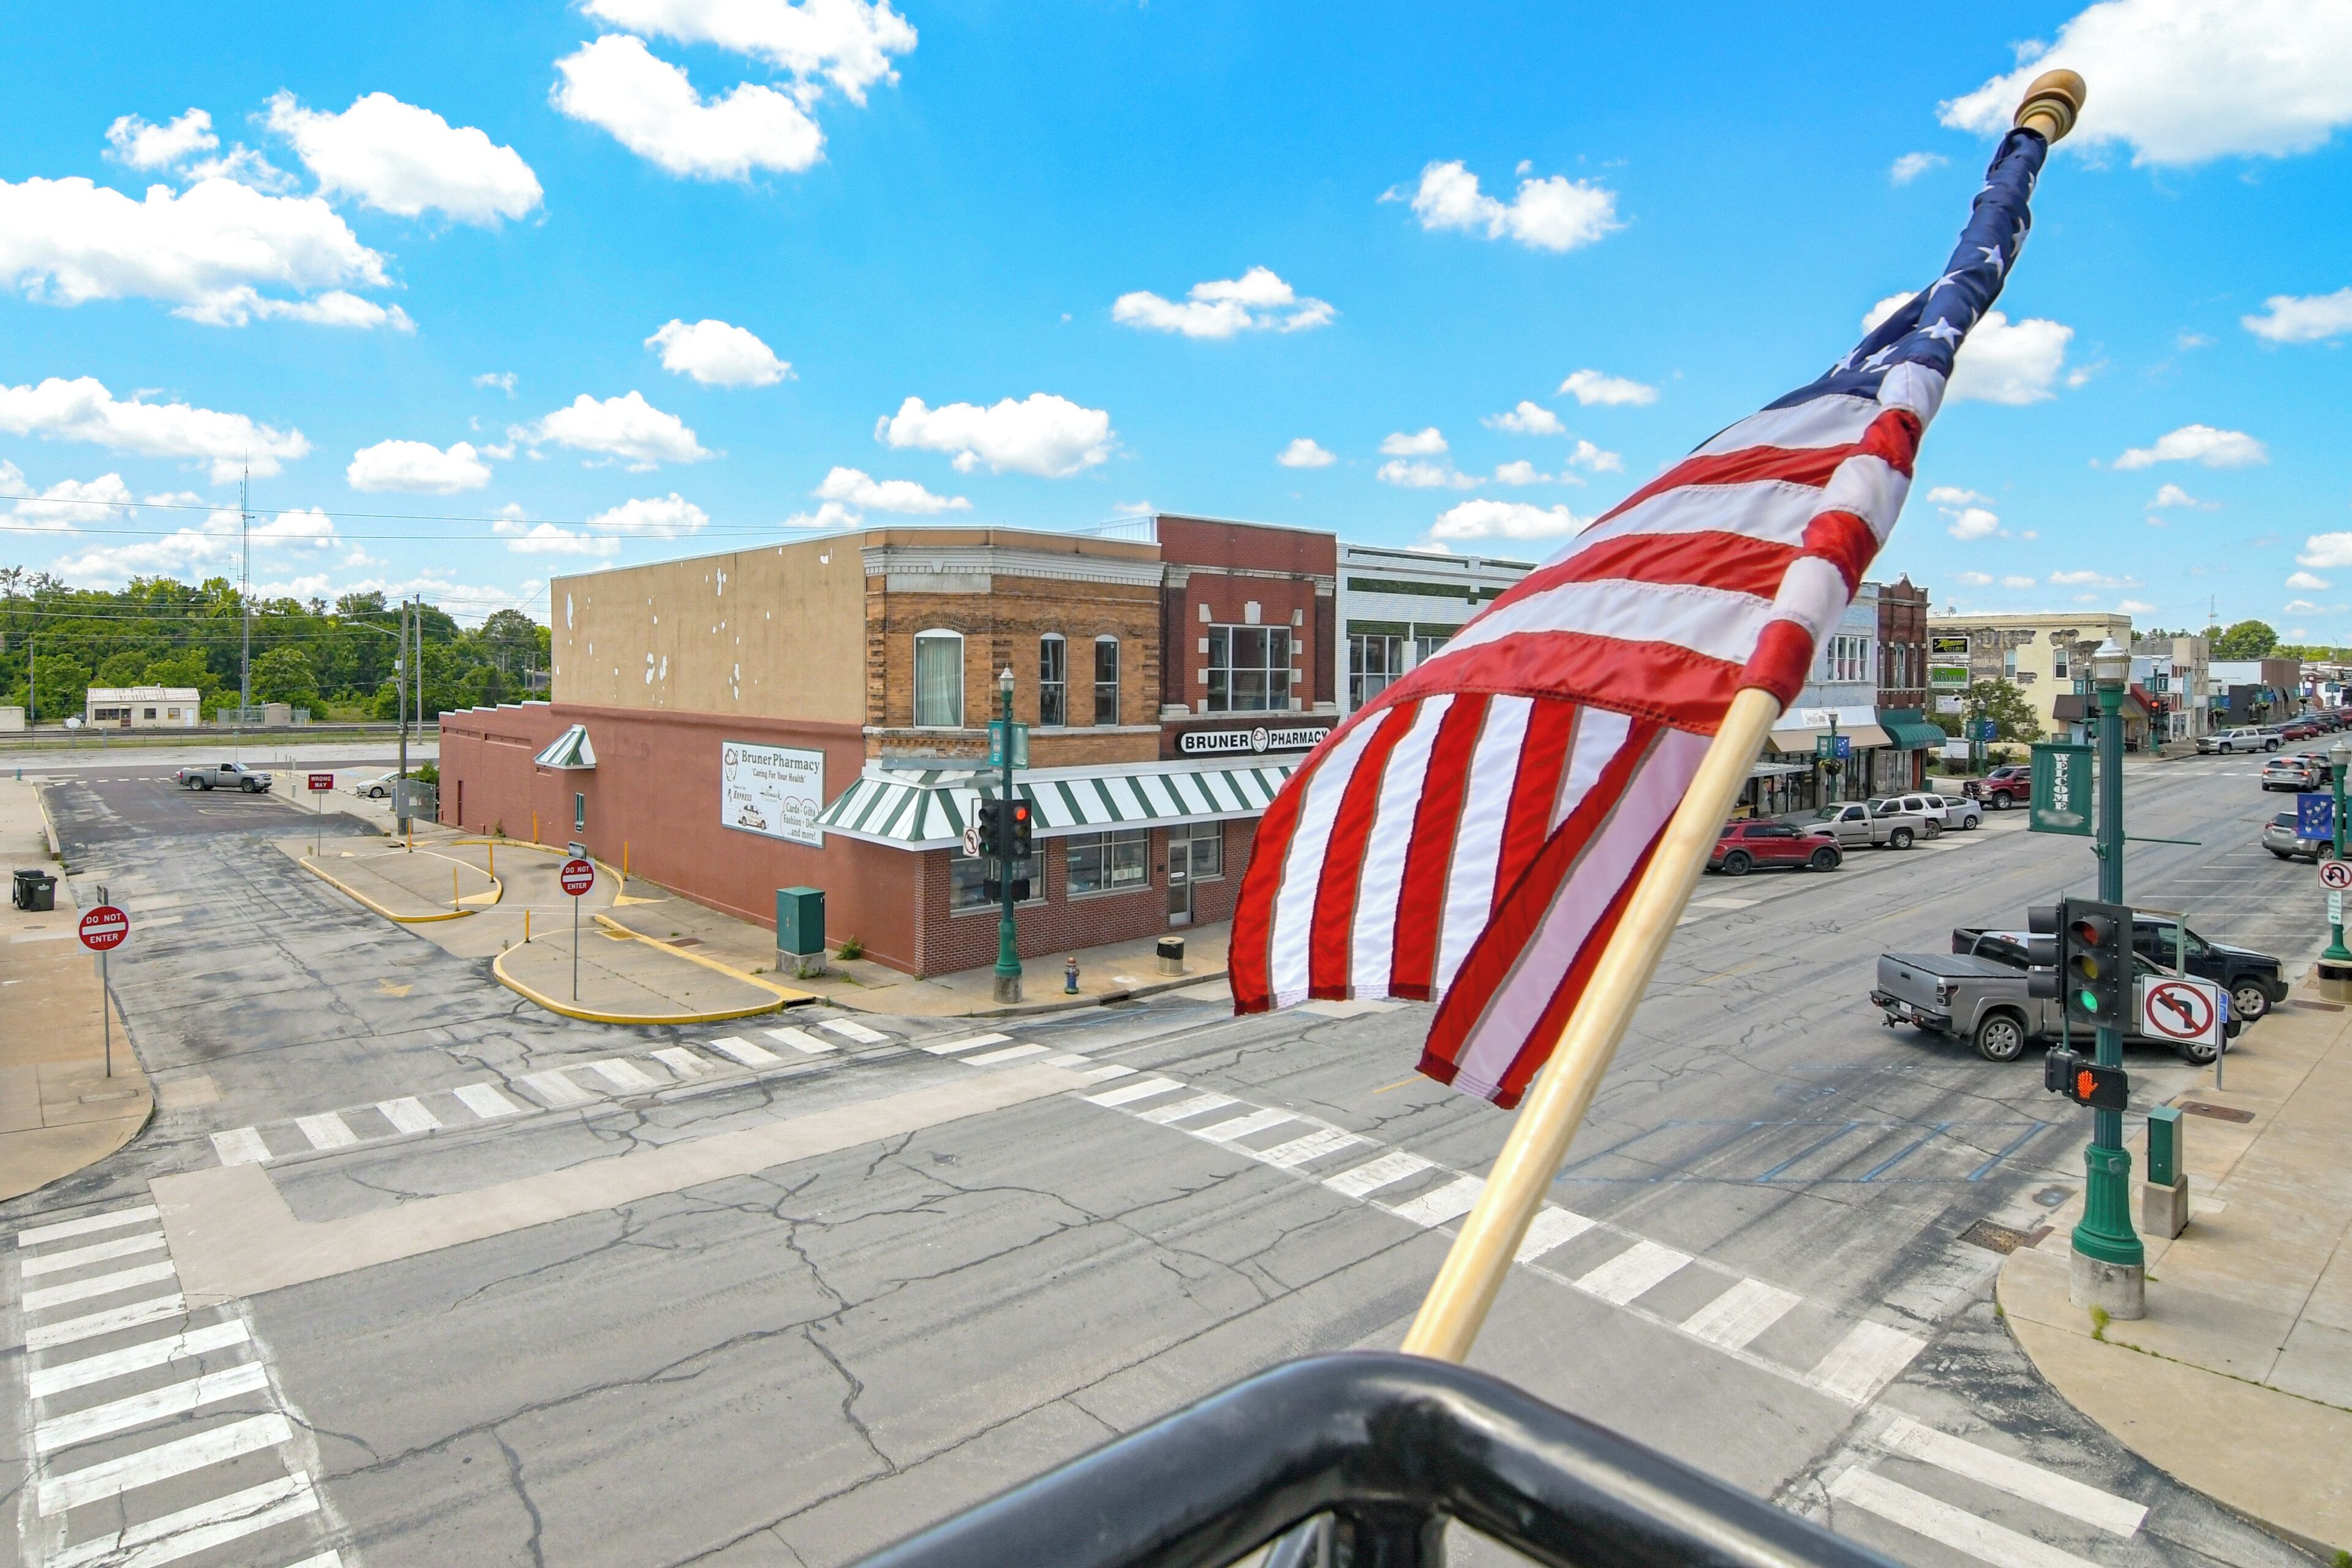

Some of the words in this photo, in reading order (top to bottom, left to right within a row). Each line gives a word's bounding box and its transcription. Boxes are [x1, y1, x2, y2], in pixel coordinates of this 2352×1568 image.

[1185, 734, 1248, 749] BRUNER
[1272, 730, 1327, 745] PHARMACY
[742, 750, 772, 765] Bruner
[773, 753, 820, 774] Pharmacy
[777, 771, 787, 781] Your
[2052, 753, 2070, 810] WELCOME
[786, 802, 799, 813] Cards
[804, 806, 815, 817] Gifts
[783, 814, 801, 826] Fashion
[802, 831, 816, 840] more!
[104, 913, 121, 922] NOT
[90, 933, 118, 943] ENTER
